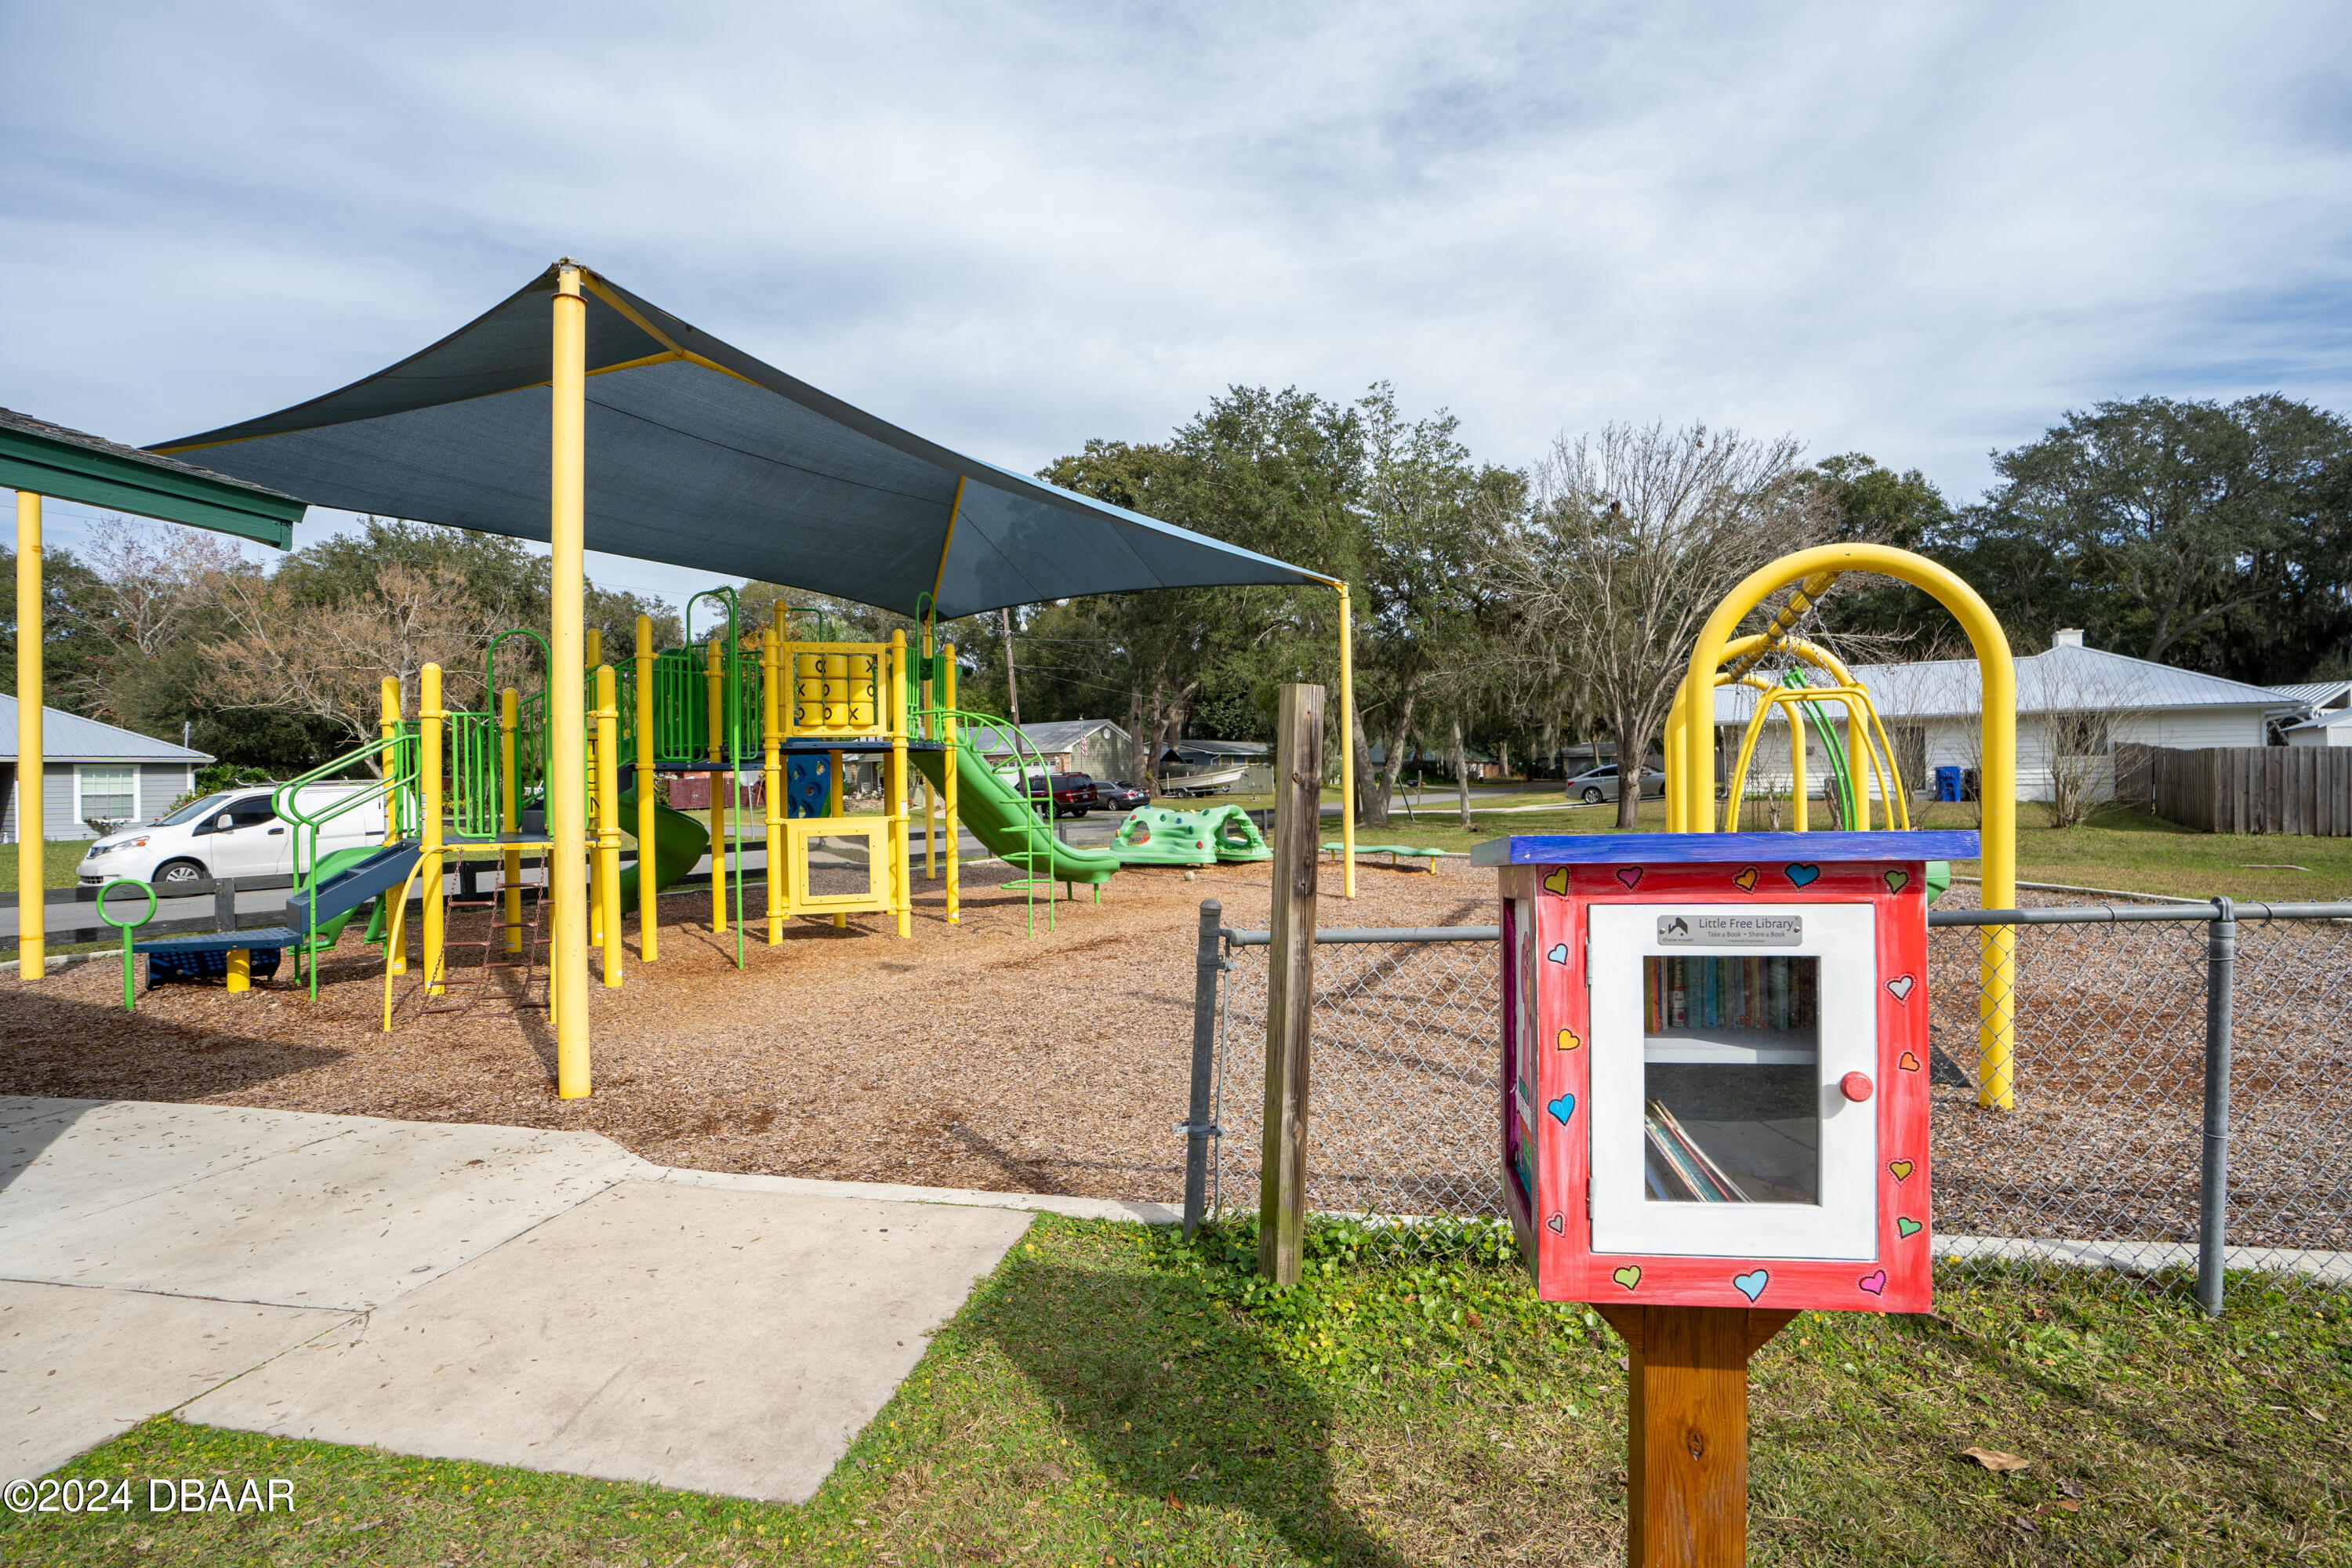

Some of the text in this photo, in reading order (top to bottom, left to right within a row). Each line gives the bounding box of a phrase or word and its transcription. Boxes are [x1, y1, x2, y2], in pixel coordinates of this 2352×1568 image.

[1699, 917, 1794, 931] Little Free Library
